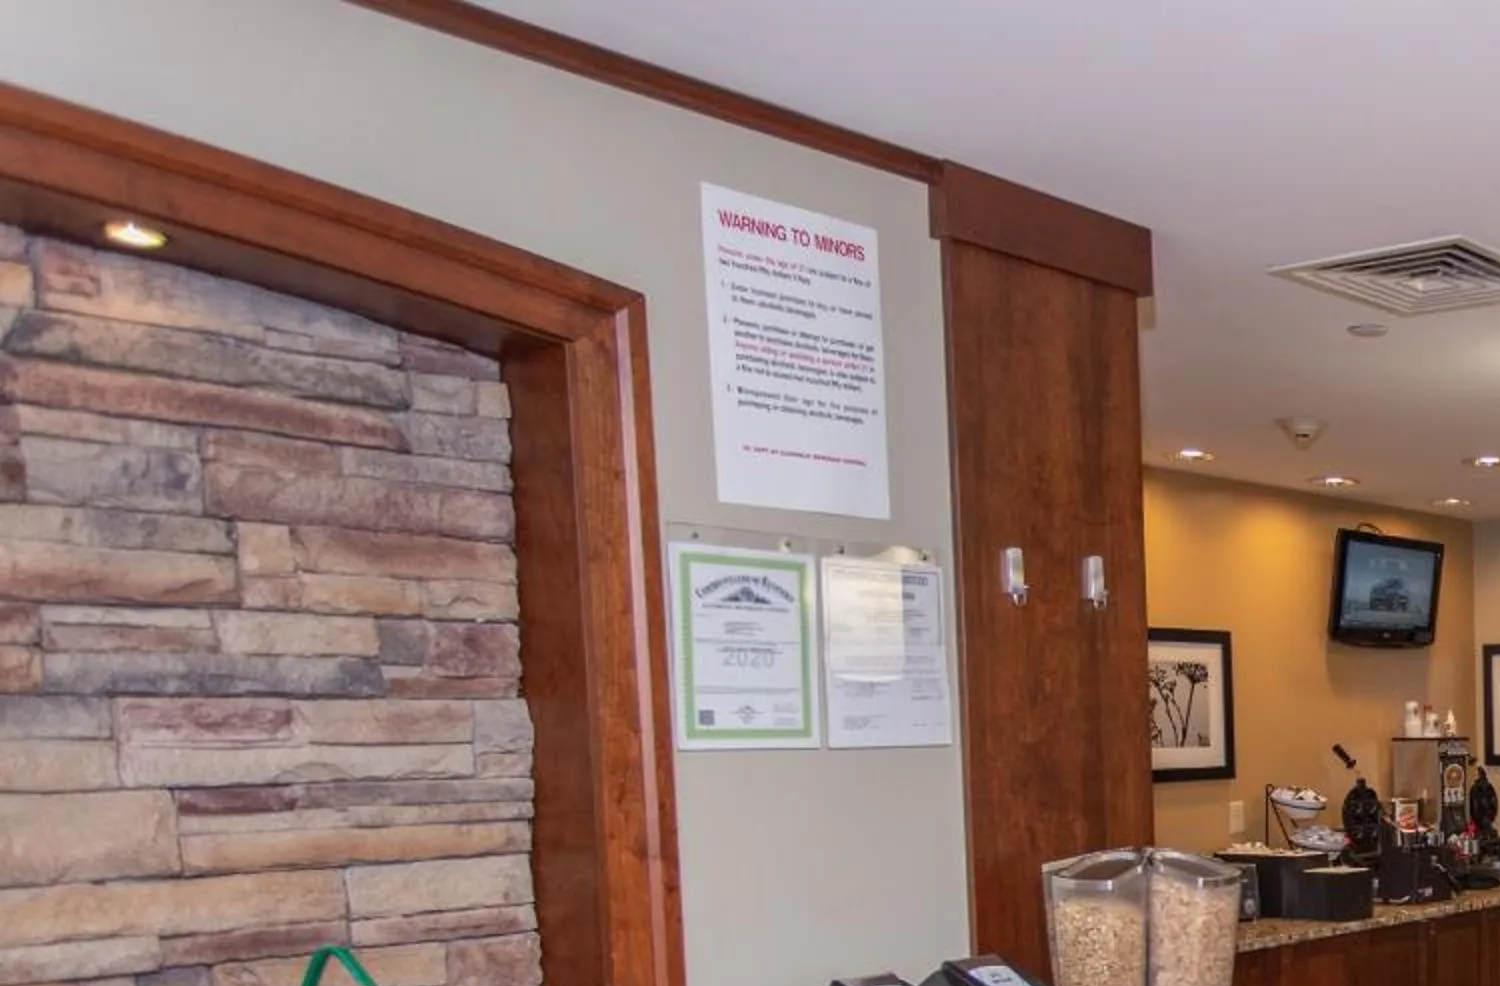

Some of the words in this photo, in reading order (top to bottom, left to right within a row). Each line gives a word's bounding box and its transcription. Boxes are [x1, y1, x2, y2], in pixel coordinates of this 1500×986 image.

[717, 209, 787, 241] WARNING
[790, 227, 811, 248] TO
[814, 233, 866, 262] MINORS
